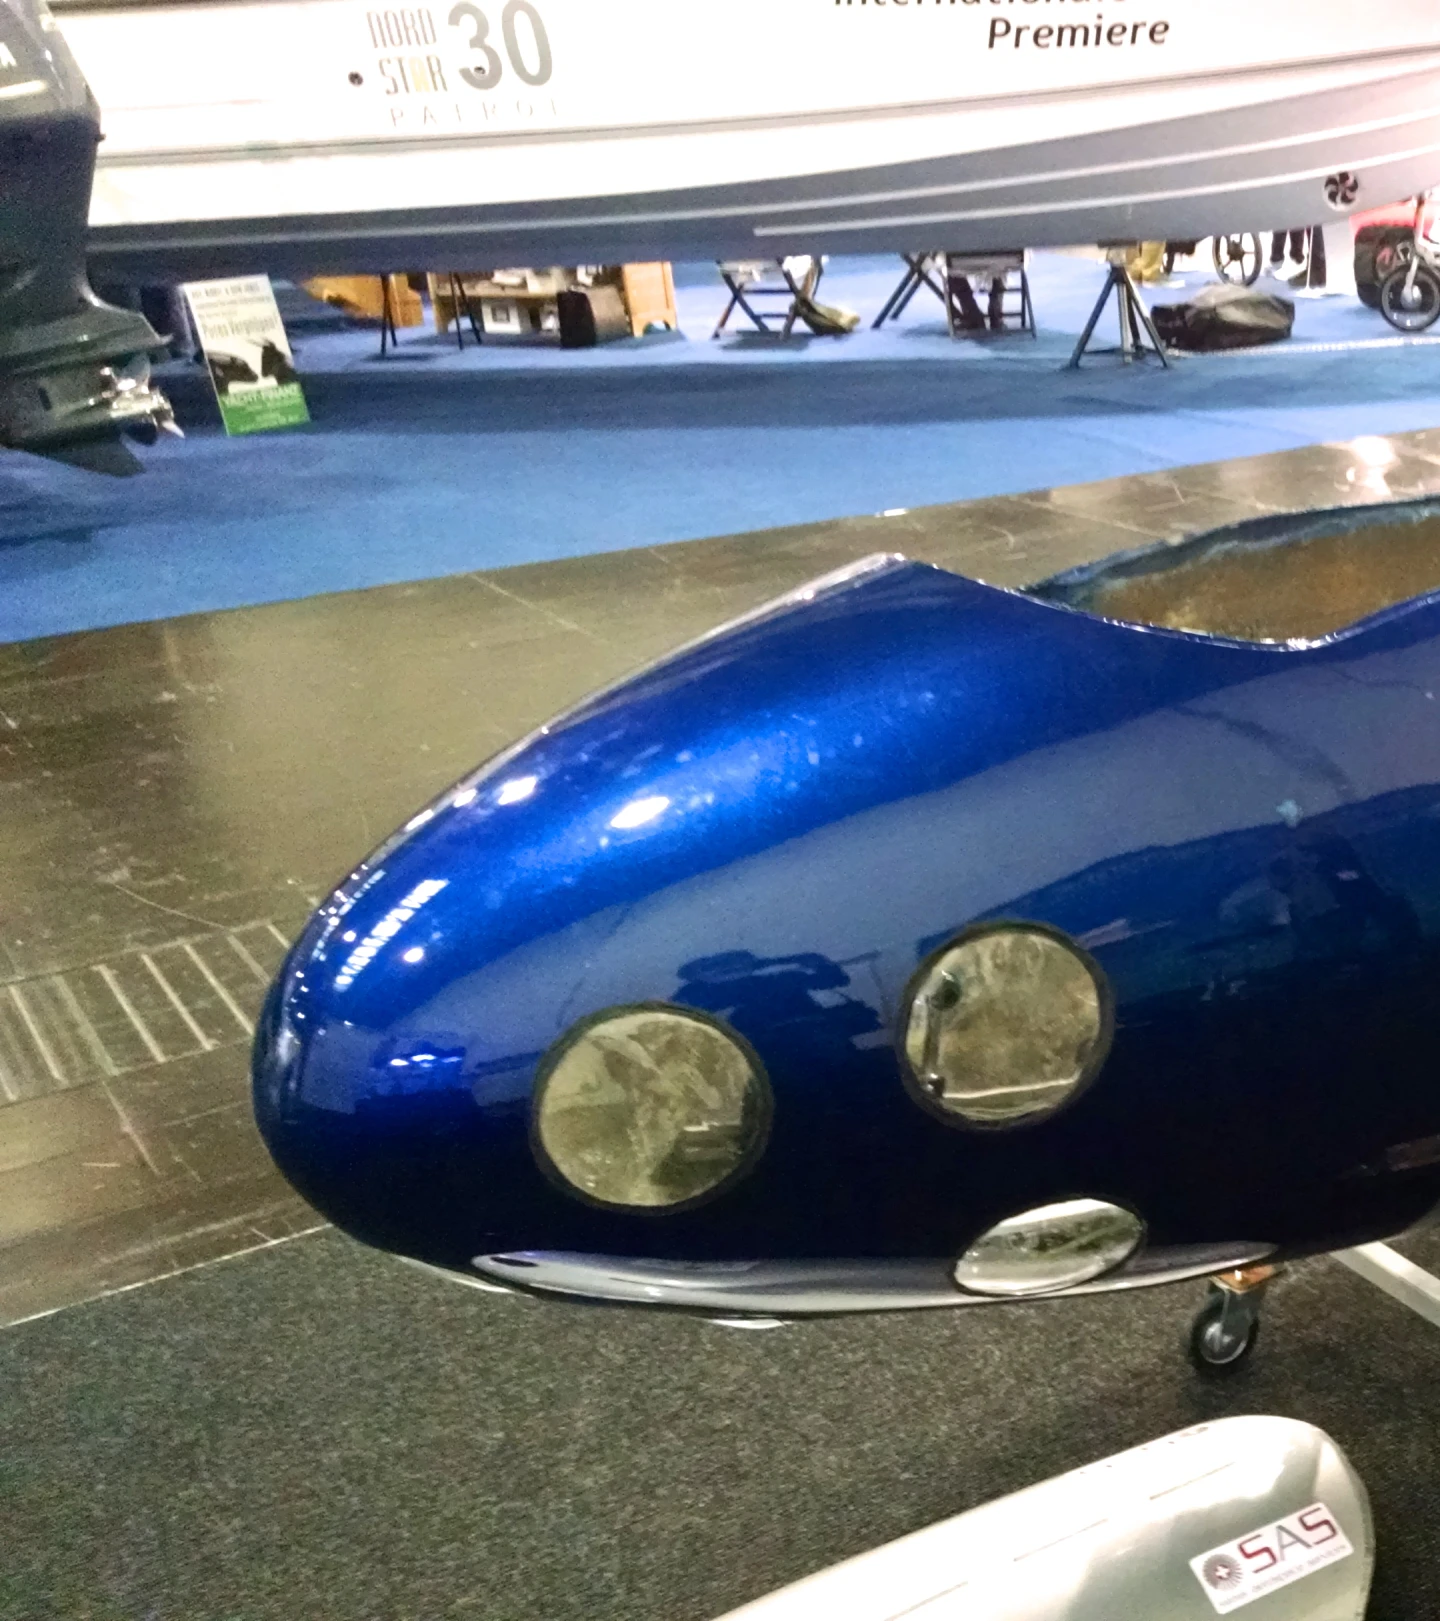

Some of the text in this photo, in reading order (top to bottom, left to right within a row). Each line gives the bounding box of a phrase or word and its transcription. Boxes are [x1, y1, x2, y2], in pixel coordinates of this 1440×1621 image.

[366, 8, 437, 49] NORD
[447, 0, 553, 90] 30
[987, 13, 1171, 49] Premiere
[378, 54, 448, 96] STAR
[1238, 1507, 1337, 1574] SAS
